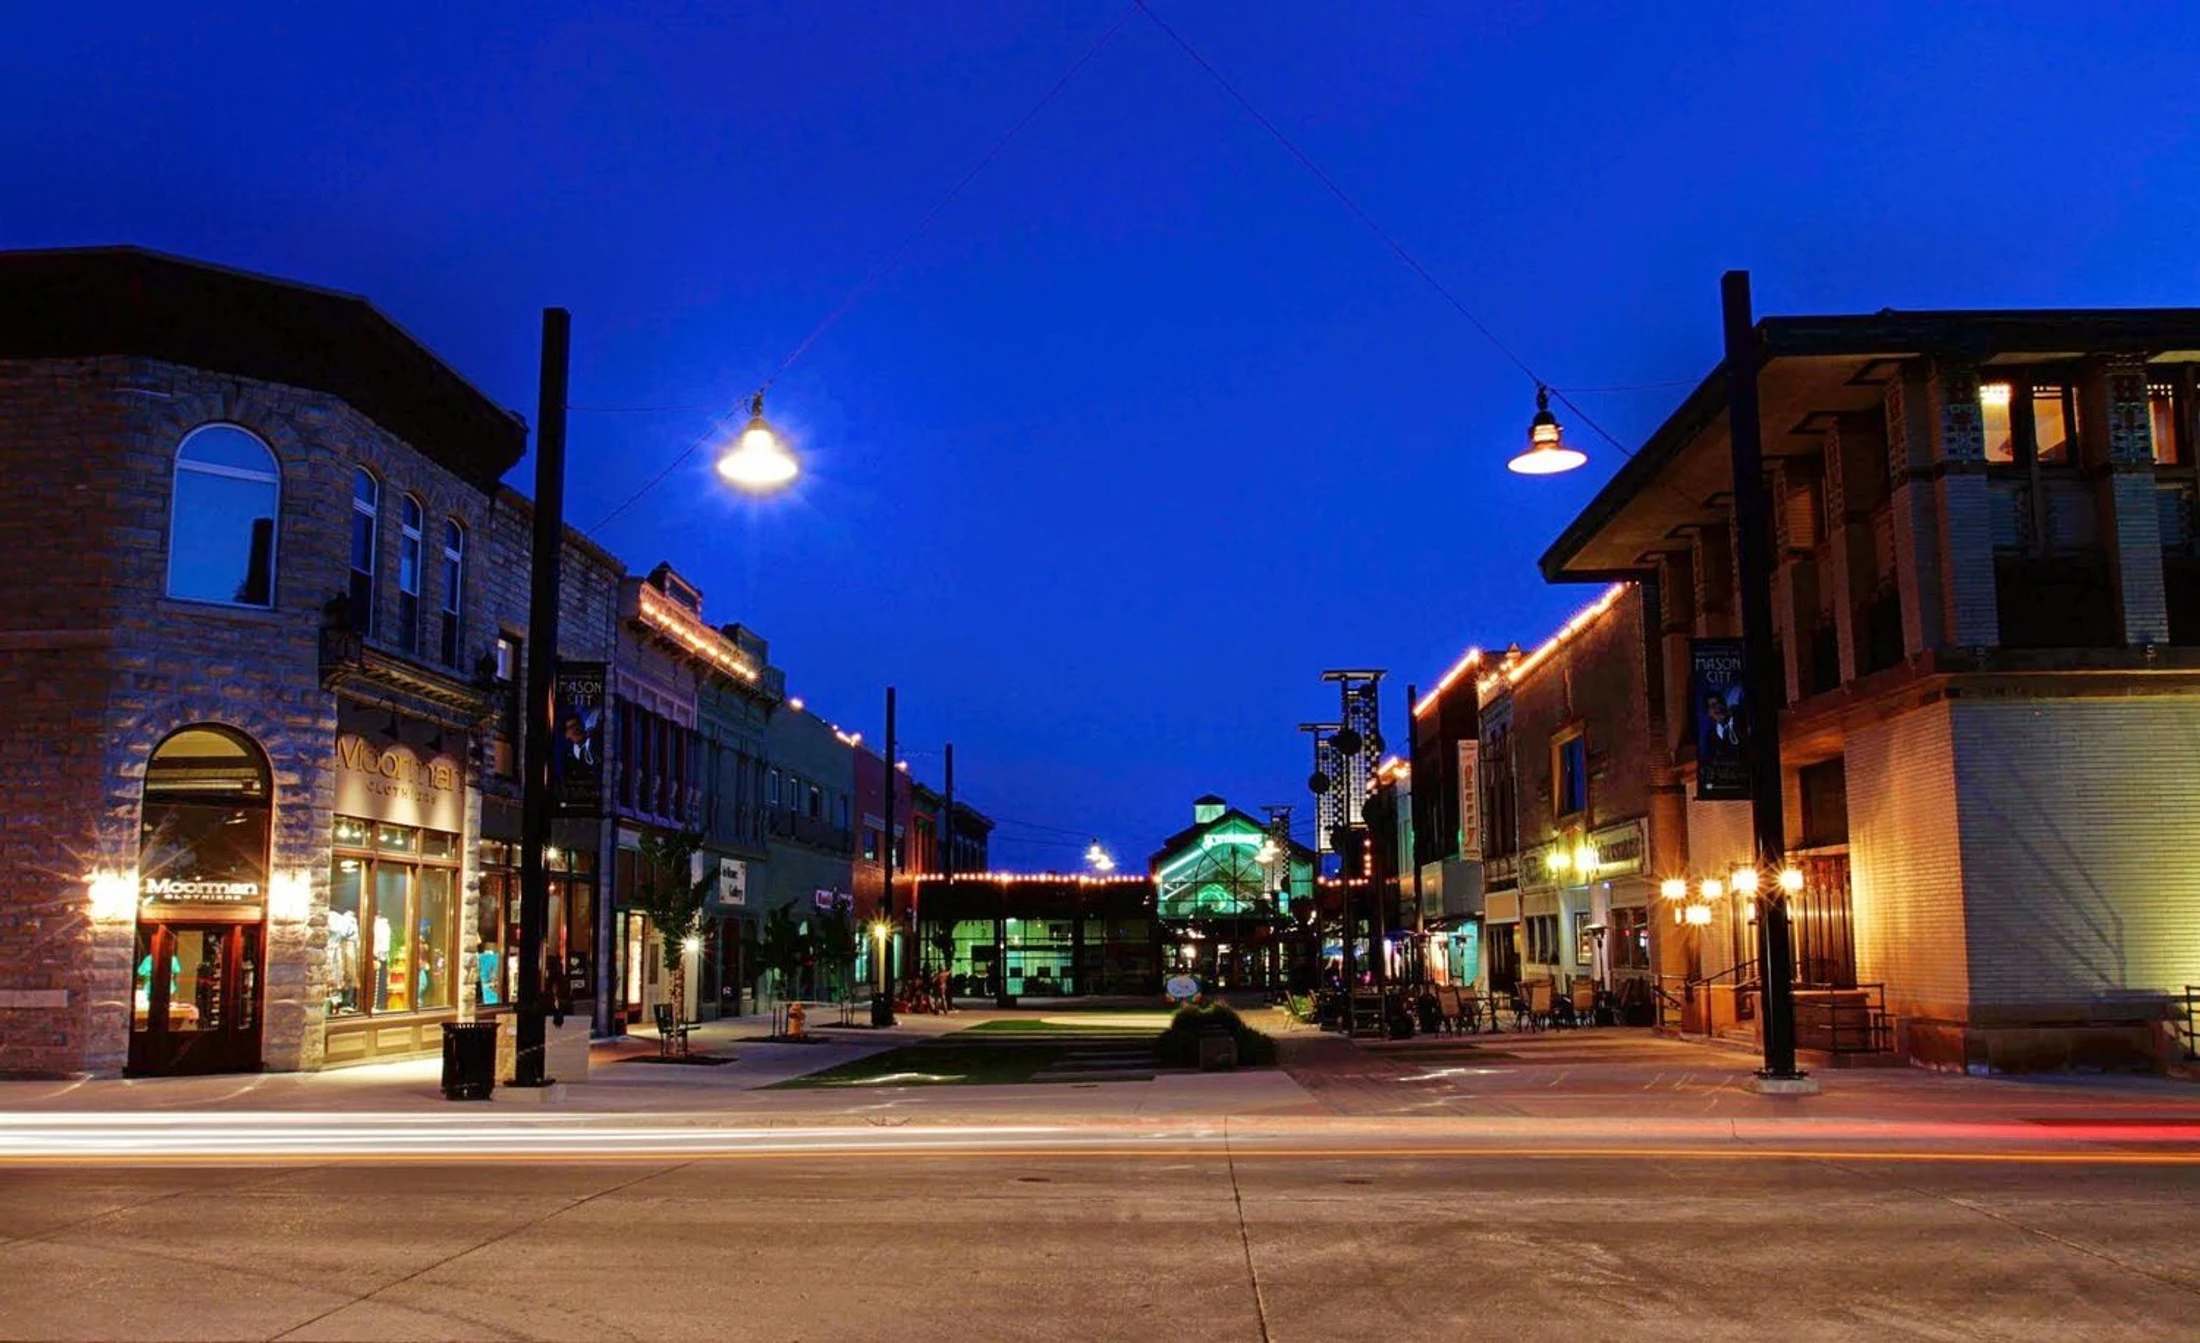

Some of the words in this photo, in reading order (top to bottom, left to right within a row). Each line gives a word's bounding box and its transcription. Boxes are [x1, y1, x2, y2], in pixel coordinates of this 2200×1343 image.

[1695, 656, 1742, 671] MASON
[337, 734, 465, 793] Moorma
[145, 878, 259, 896] Moorman
